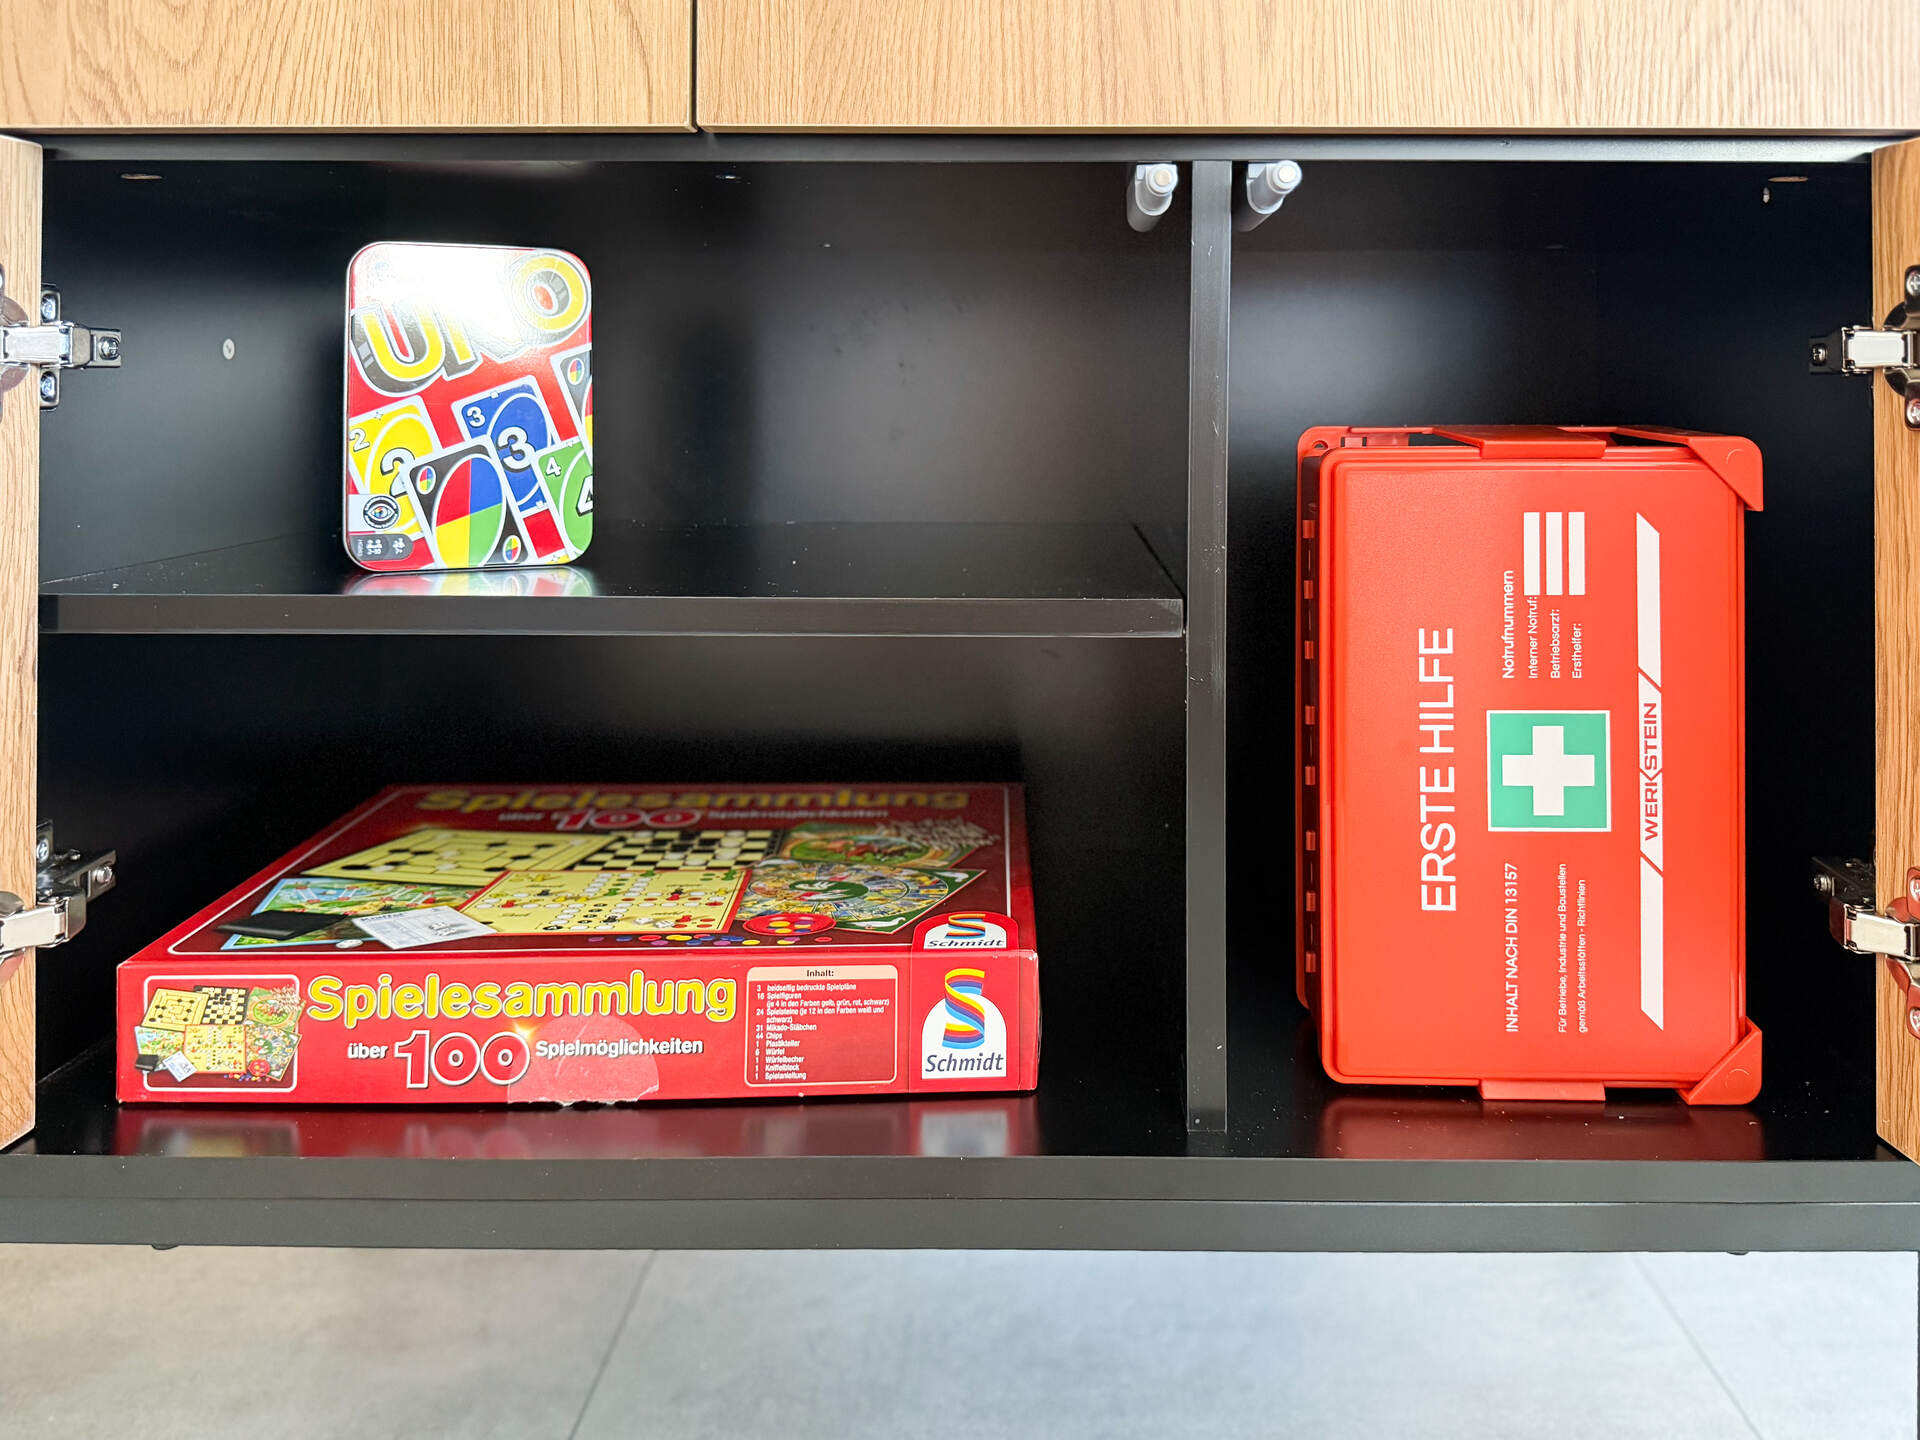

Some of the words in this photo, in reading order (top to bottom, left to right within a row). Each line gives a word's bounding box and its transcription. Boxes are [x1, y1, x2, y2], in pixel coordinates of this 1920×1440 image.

[466, 406, 486, 427] 3
[349, 428, 371, 452] 2
[497, 427, 537, 473] 3
[545, 457, 562, 477] 4
[1501, 570, 1515, 678] Notrufnummern
[1527, 596, 1538, 633] Notruf:
[1527, 635, 1538, 678] Interner
[1550, 608, 1561, 678] Betriebsarzt:
[1571, 623, 1582, 678] Ersthelfer:
[1418, 627, 1455, 753] HILFE
[1643, 702, 1660, 840] WERKSTEIN
[552, 808, 701, 830] 100
[1420, 767, 1457, 911] ERSTE
[1505, 863, 1518, 903] 13157
[1558, 864, 1567, 912] Baustellen
[1576, 879, 1586, 927] Richtlinien
[1505, 908, 1518, 933] DIN
[1558, 914, 1567, 931] und
[928, 938, 1004, 948] Schmidt
[1505, 937, 1519, 978] NACH
[1558, 933, 1567, 973] Industrie
[806, 969, 834, 977] Inhalt:
[306, 969, 737, 1029] Spielesammlung
[756, 1008, 765, 1016] 24
[1505, 982, 1519, 1032] INHALT
[1558, 975, 1569, 1016] Betriebe,
[756, 1032, 764, 1040] 44
[766, 1032, 783, 1040] Chips
[1558, 1018, 1567, 1033] Für
[347, 1041, 388, 1061] über
[394, 1028, 531, 1089] 100
[535, 1037, 704, 1060] Spielmöglichkeiten
[925, 1052, 1005, 1073] Schmidt
